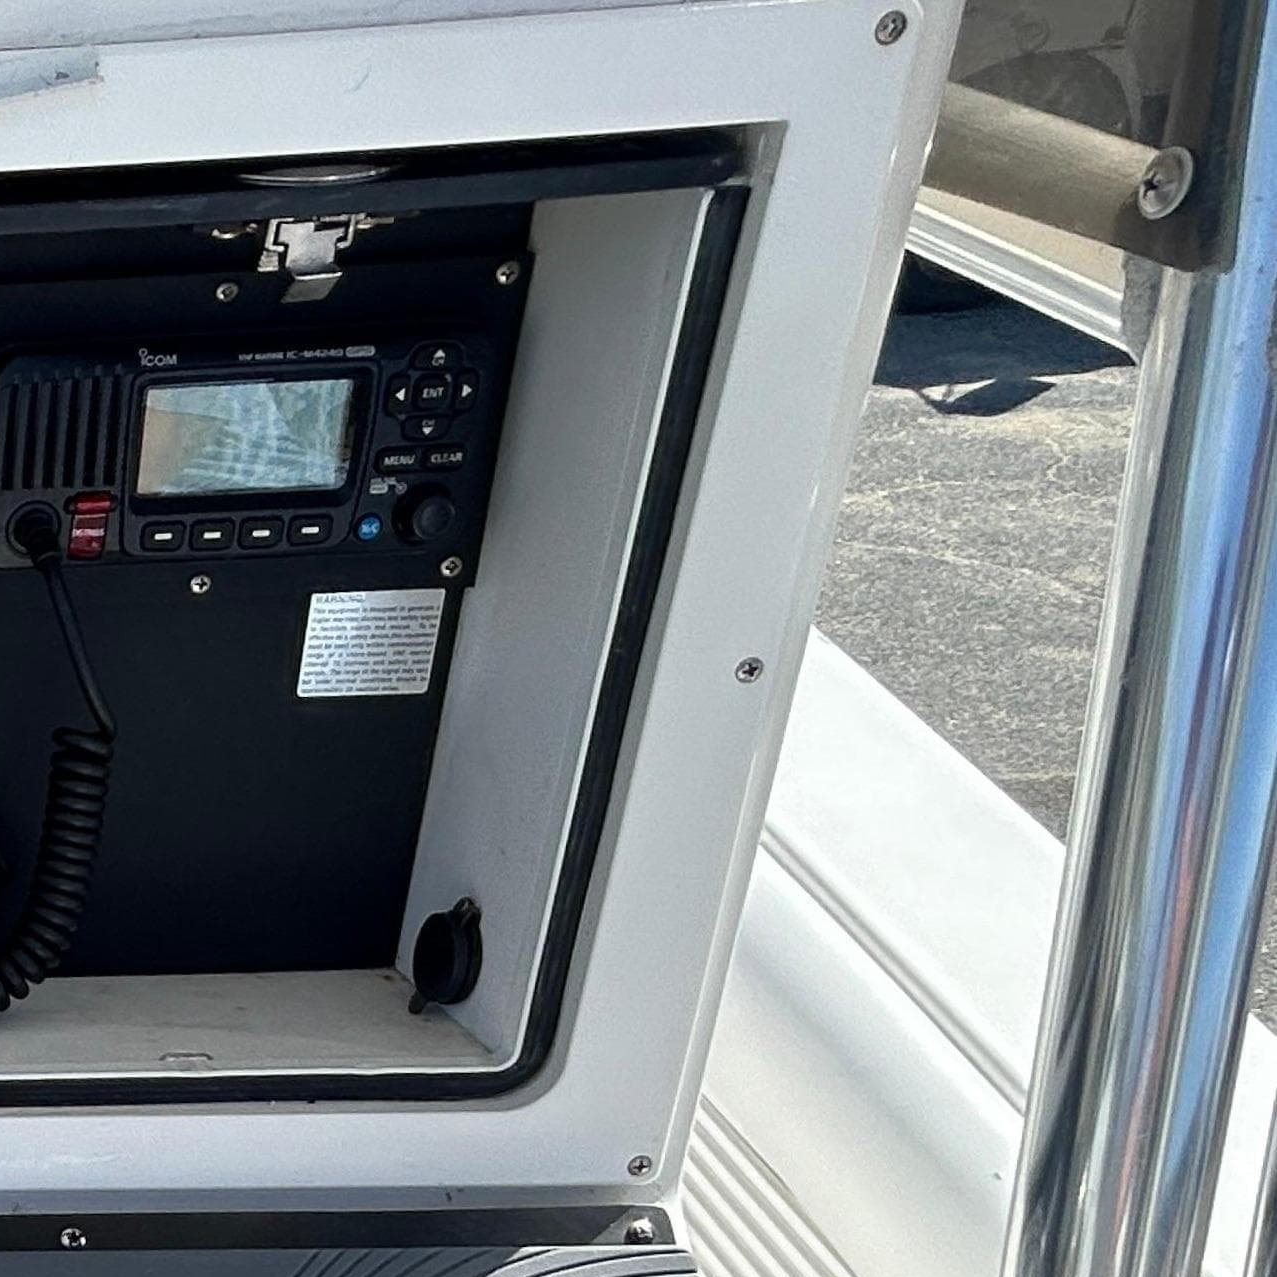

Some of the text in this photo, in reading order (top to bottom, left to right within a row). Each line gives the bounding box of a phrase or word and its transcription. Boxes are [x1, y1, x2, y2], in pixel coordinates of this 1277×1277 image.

[422, 387, 444, 399] ENT
[383, 454, 415, 466] MENU
[430, 452, 463, 464] CLEAR
